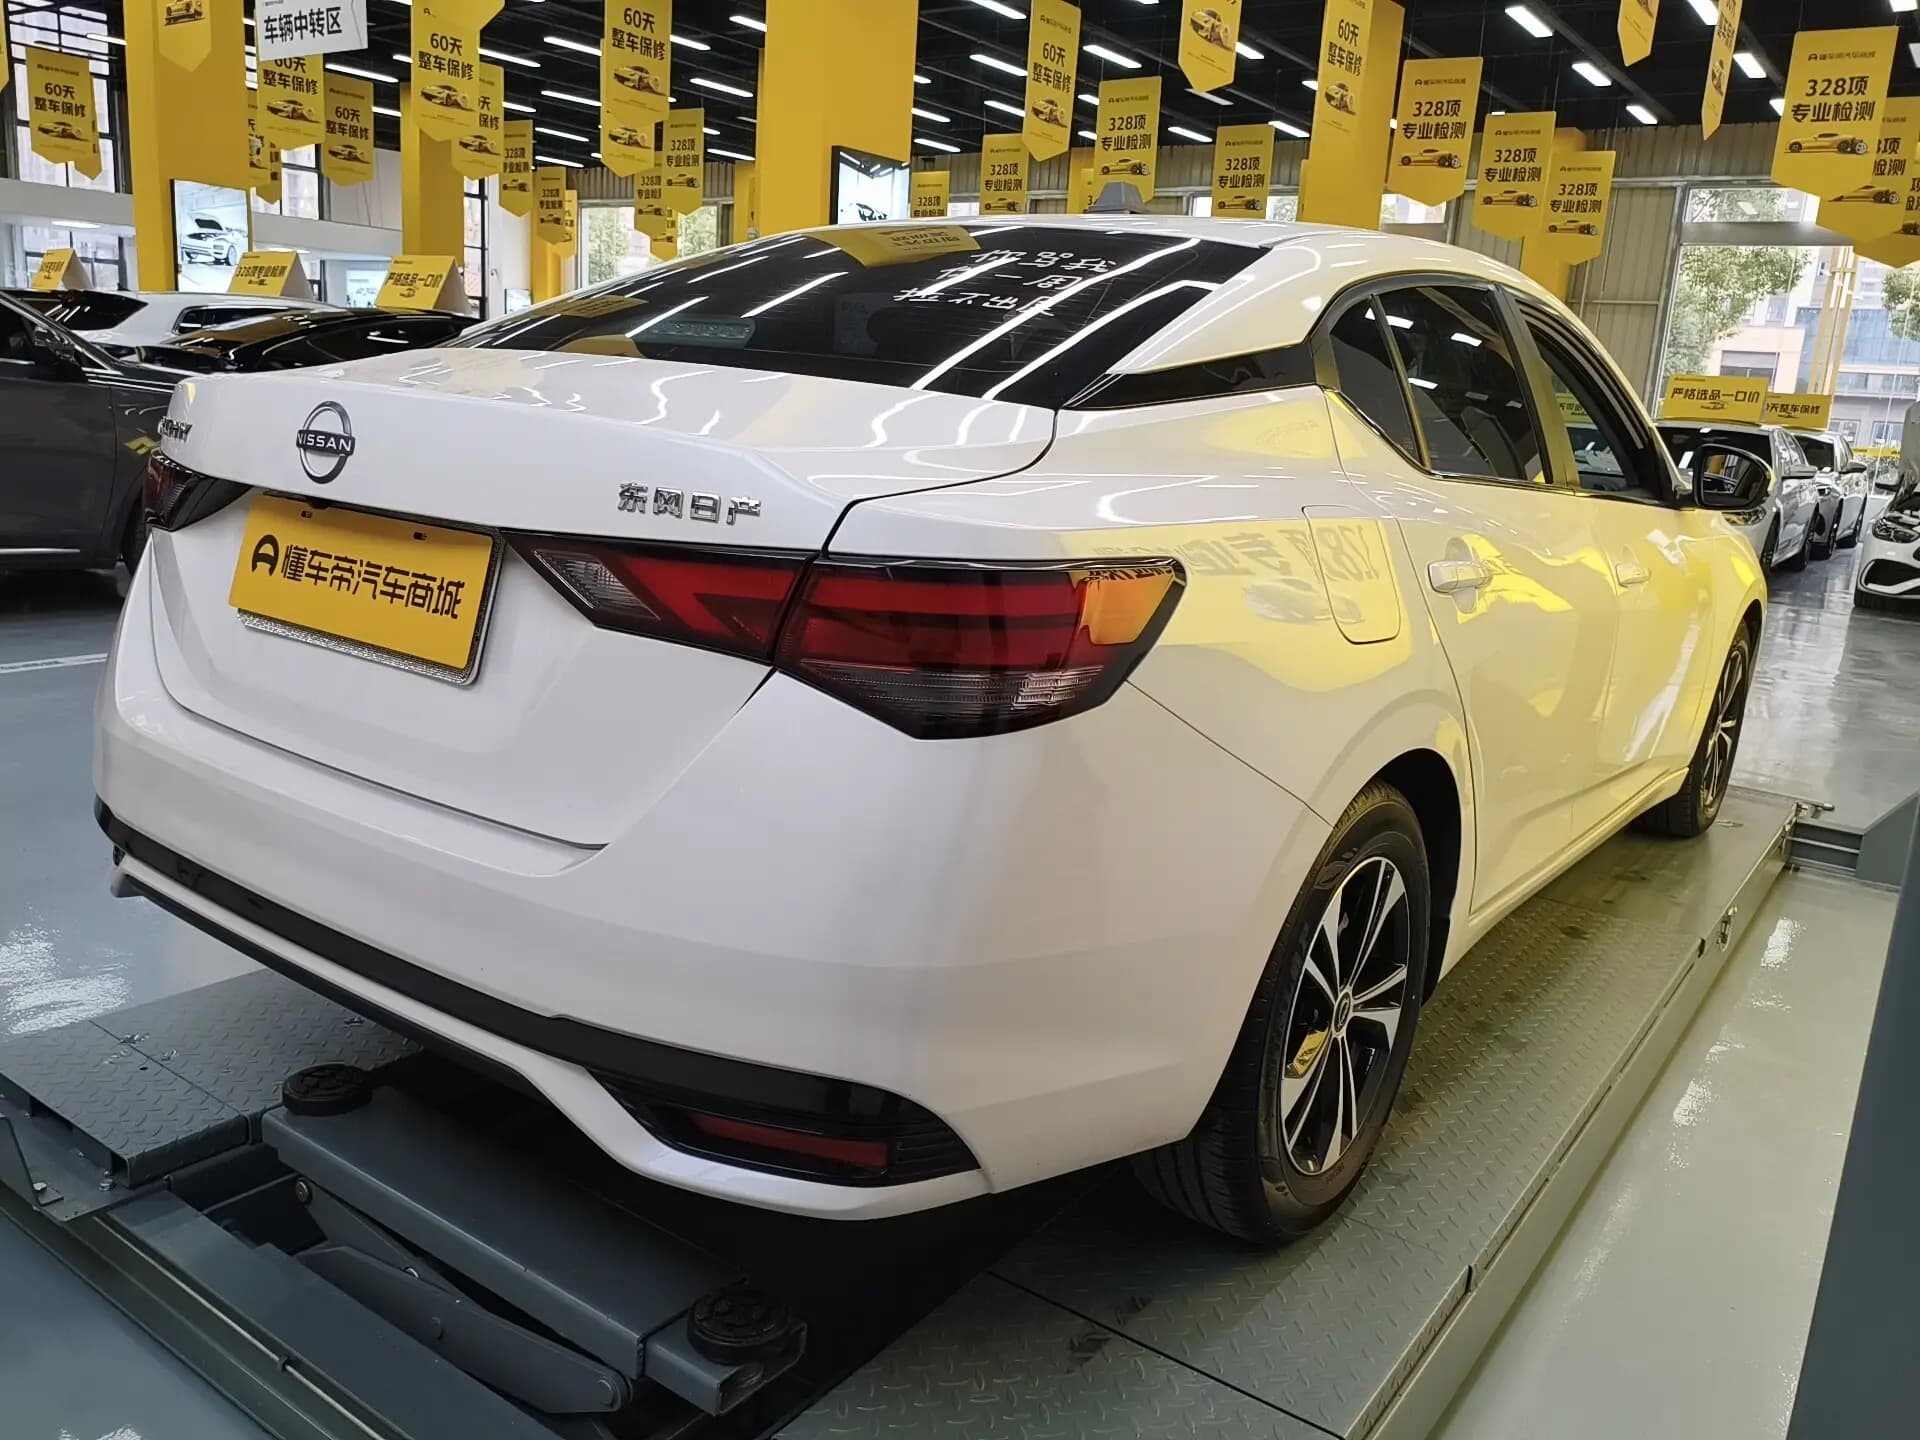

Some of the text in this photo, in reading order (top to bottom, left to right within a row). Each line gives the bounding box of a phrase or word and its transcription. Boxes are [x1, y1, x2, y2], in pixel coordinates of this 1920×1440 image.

[264, 7, 342, 44] 车辆中转区
[624, 7, 655, 34] 60天
[1338, 18, 1359, 47] 60天
[430, 33, 462, 56] 60天
[612, 27, 665, 61] 整车保修
[1042, 42, 1066, 68] 60天
[1327, 41, 1362, 77] 整车保修
[418, 50, 474, 80] 整车保修
[263, 69, 318, 95] 整车保修
[1032, 61, 1071, 94] 整车保修
[1805, 76, 1869, 96] 328项
[45, 82, 75, 100] 60天
[34, 96, 86, 118] 整车保修
[335, 106, 360, 123] 60天
[1413, 99, 1462, 117] 328项
[1792, 101, 1876, 123] 专业检测
[326, 120, 368, 140] 整车保修
[1108, 114, 1147, 131] 328项
[1402, 121, 1467, 140] 专业检测
[671, 139, 696, 151] 328项
[1101, 134, 1151, 152] 专业检测
[1225, 156, 1261, 171] 328项
[1494, 148, 1537, 163] 328项
[990, 163, 1019, 176] 328项
[1484, 167, 1542, 183] 专业检测
[985, 178, 1022, 192] 专业检测
[1218, 174, 1265, 189] 专业检测
[1558, 183, 1598, 197] 328项
[918, 196, 941, 207] 328项
[1550, 199, 1602, 214] 专业检测
[1671, 387, 1760, 403] 严格选品一口价
[299, 431, 353, 453] NISSAN
[617, 481, 762, 526] 东风日产
[281, 544, 466, 620] 懂车帝汽车商城
